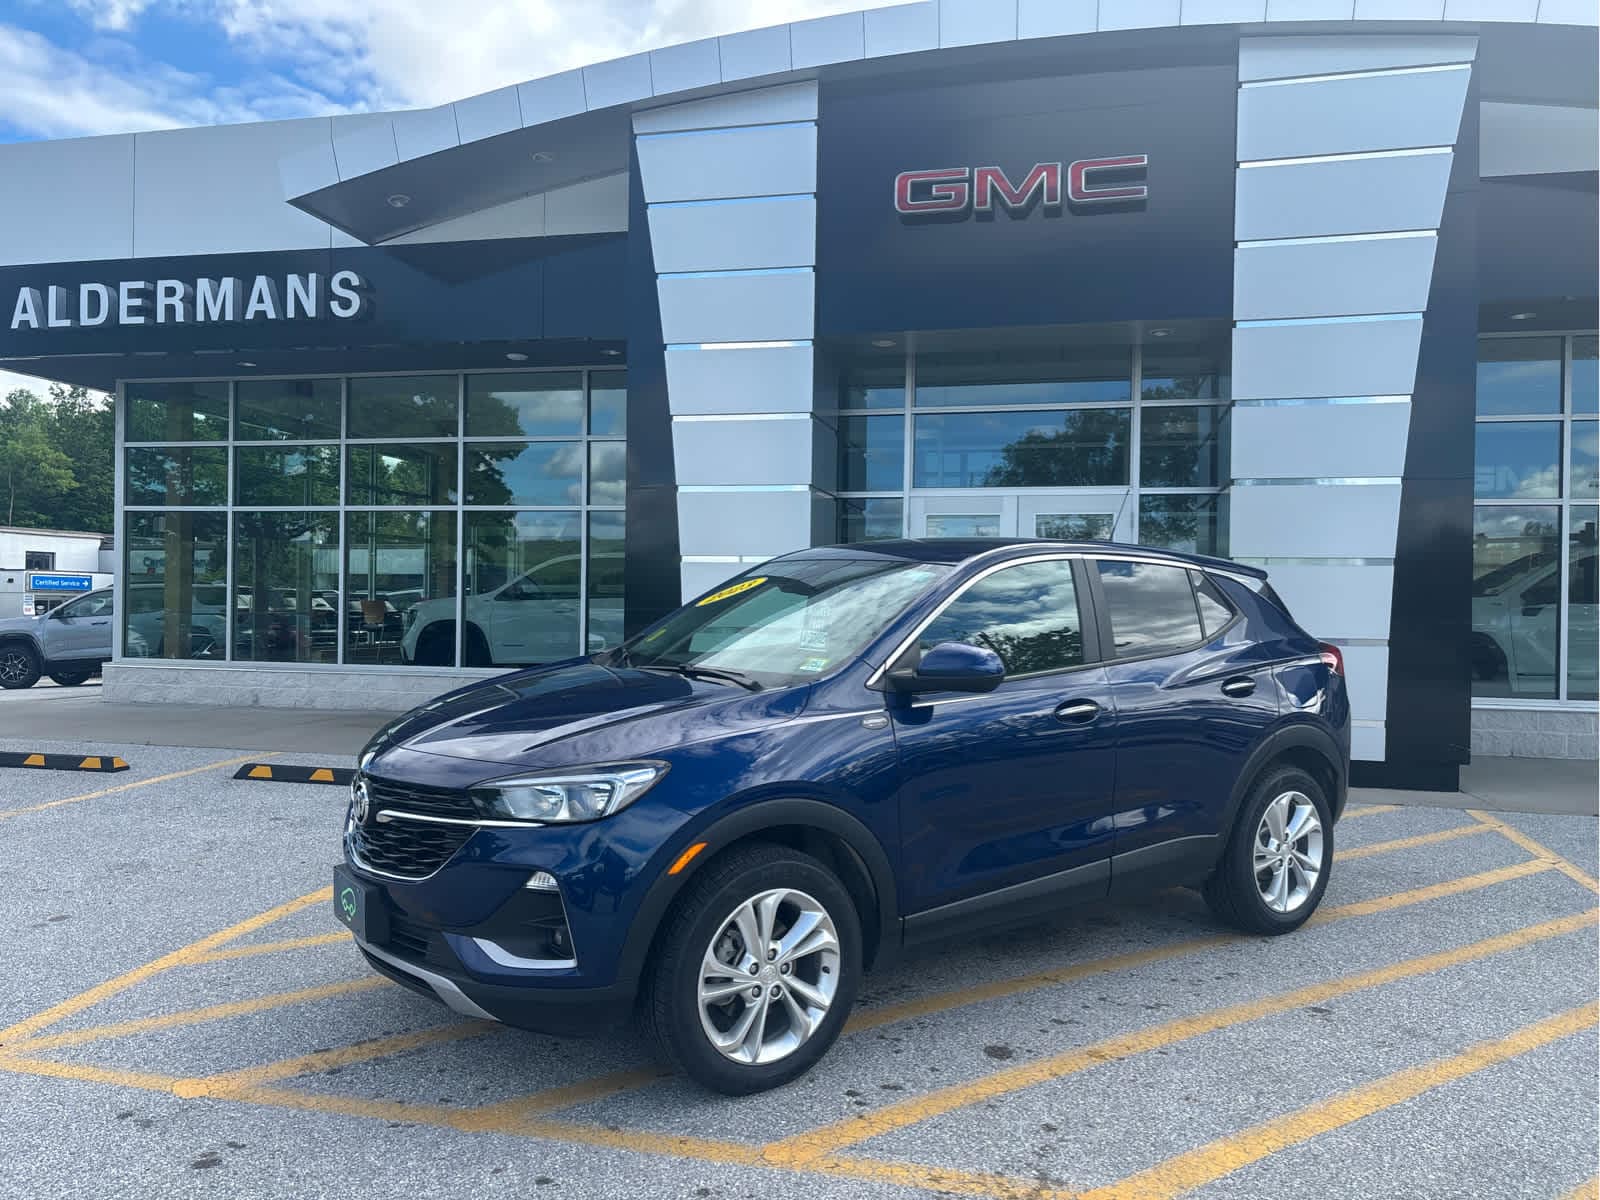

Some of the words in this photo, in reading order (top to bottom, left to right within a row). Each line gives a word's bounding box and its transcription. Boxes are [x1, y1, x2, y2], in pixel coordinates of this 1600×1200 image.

[894, 154, 1148, 213] GMC
[10, 269, 362, 329] ALDERMANS
[60, 579, 81, 587] Service
